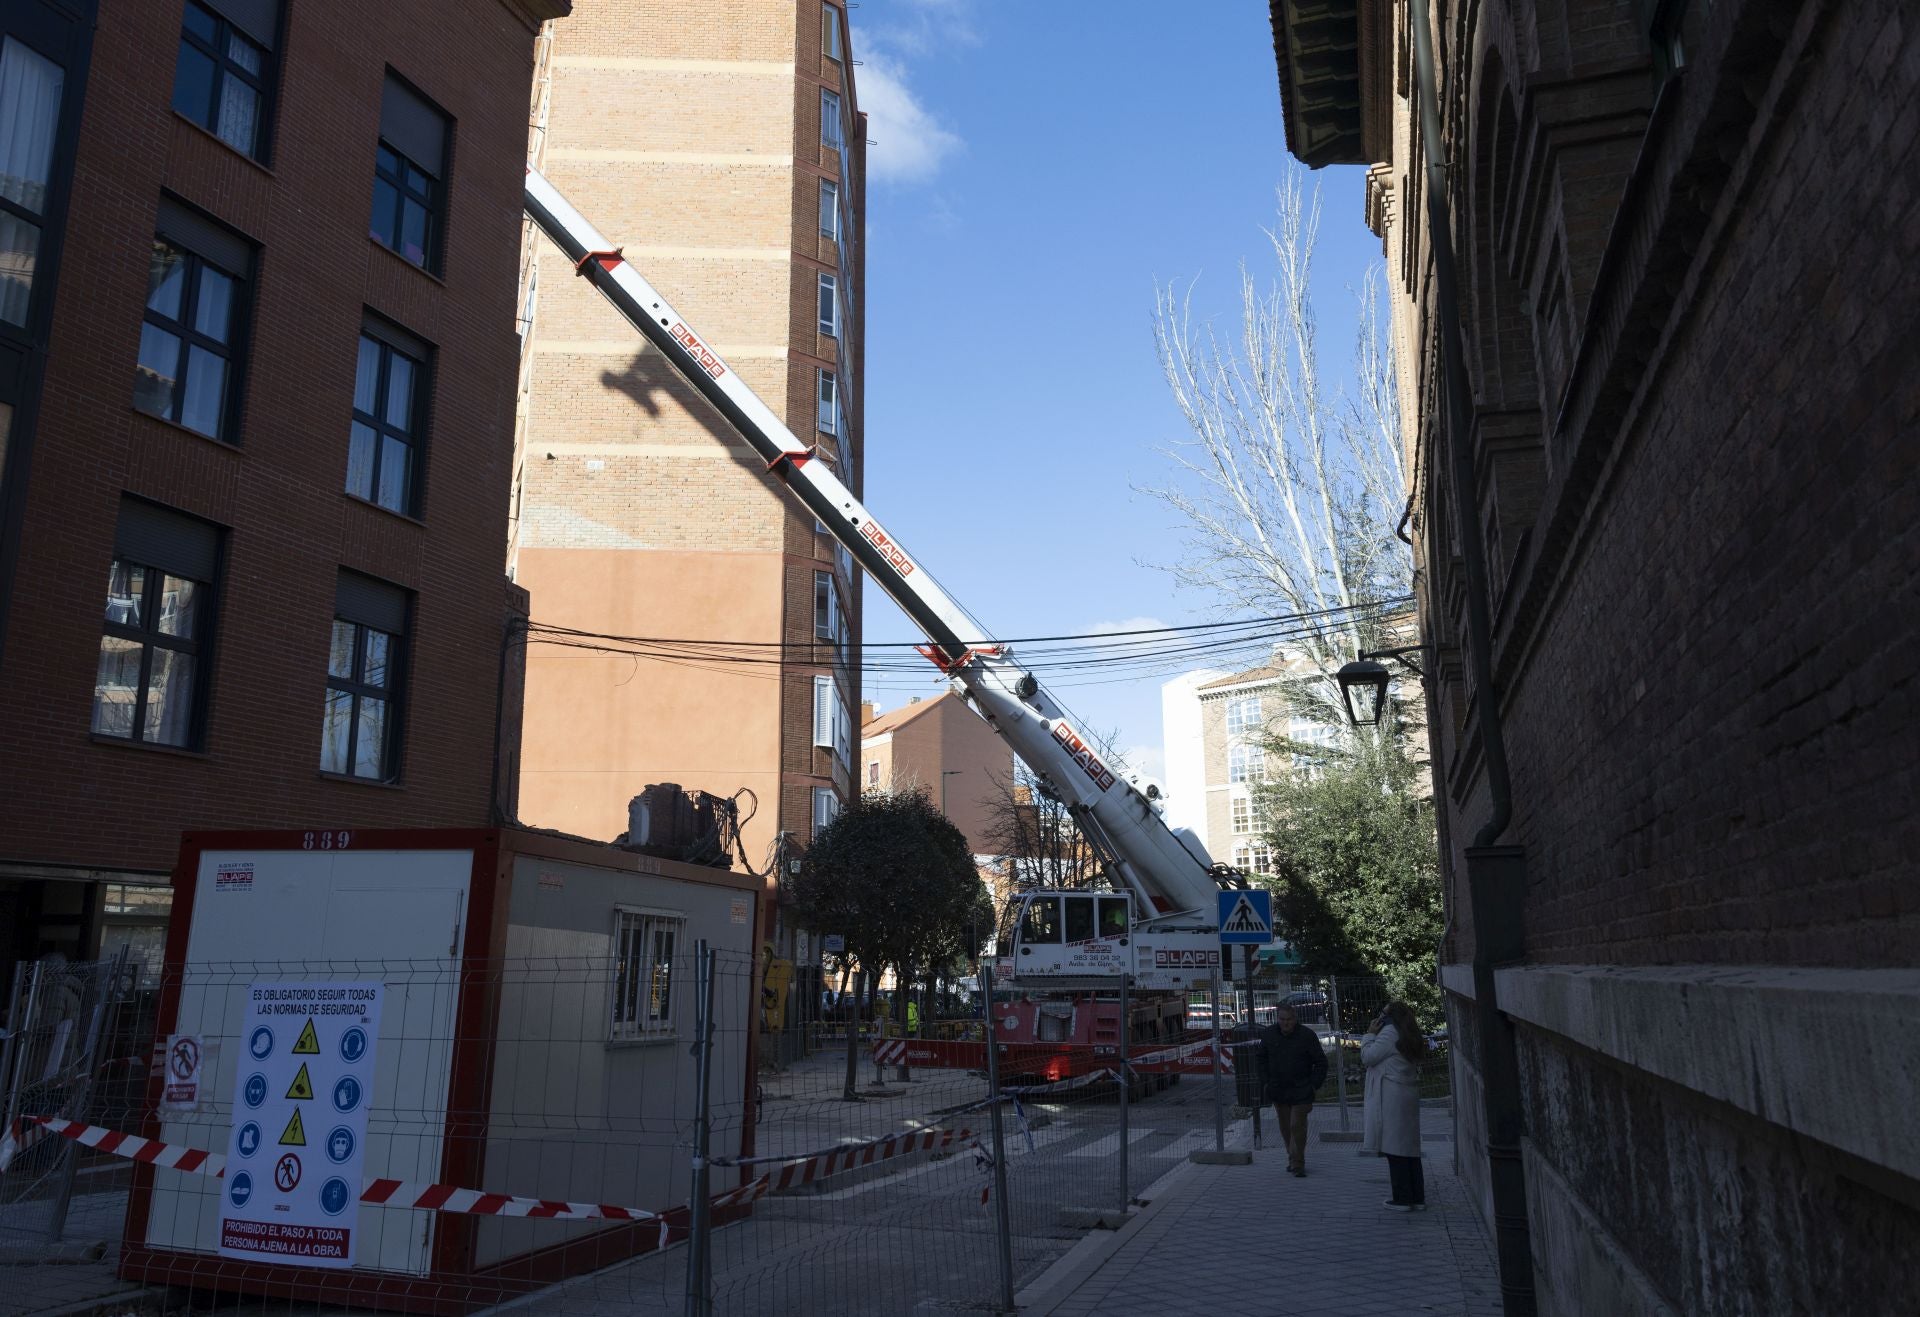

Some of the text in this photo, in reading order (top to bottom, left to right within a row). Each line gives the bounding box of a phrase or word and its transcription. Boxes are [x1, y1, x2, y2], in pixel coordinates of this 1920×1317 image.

[671, 322, 725, 378] BLAPE
[862, 521, 914, 576] BLAPE
[1054, 722, 1116, 790] BLAPE
[217, 872, 254, 882] BLAPE
[1083, 944, 1112, 952] BLAPE
[1155, 950, 1220, 965] BLAPE
[253, 989, 376, 1001] ES OBLIGATORIO SEGUIR TODAS
[257, 1004, 366, 1016] LAS NORMAS DE SEGURIDAD
[225, 1220, 343, 1241] PROHIBIDO EL PASO A TODA
[224, 1235, 341, 1256] PERSONA AJENA A LA OBRA
